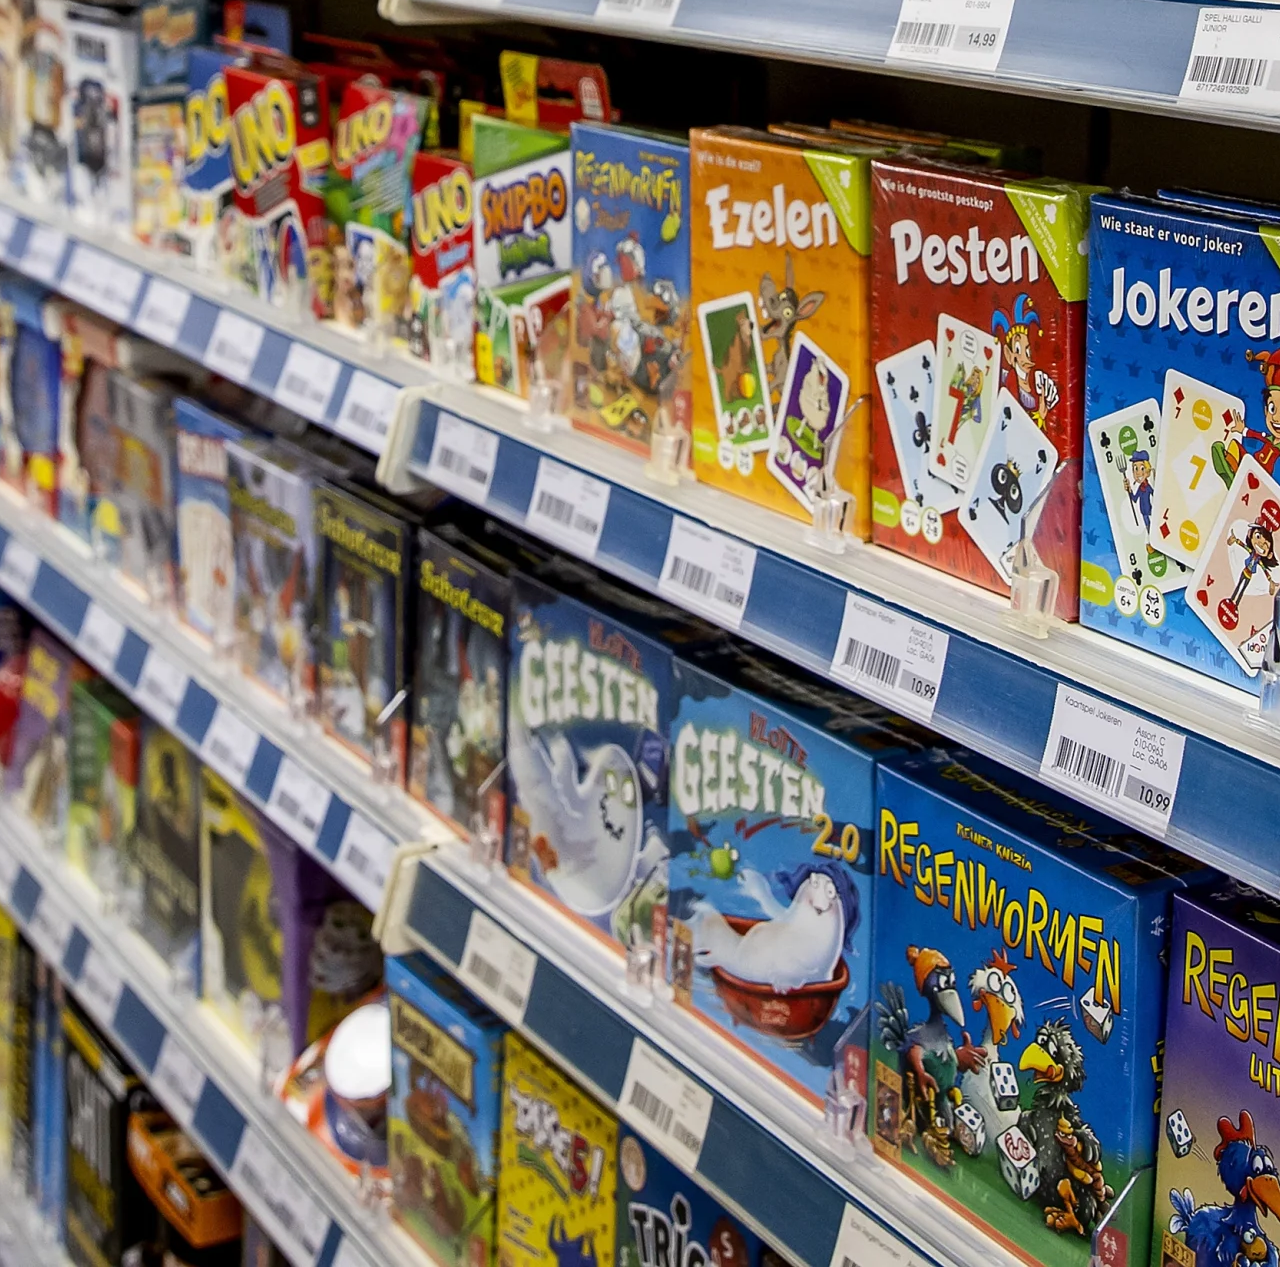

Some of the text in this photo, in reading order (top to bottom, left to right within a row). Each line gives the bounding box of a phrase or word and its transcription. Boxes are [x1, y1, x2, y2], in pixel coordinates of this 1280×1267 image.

[1202, 24, 1228, 33] JUNIOR
[1204, 13, 1263, 24] SPEL HALLI GALLI
[968, 32, 996, 48] 14,99
[230, 83, 297, 188] UNO
[336, 99, 393, 166] UNO
[413, 170, 473, 247] UNO
[897, 180, 905, 193] is
[906, 182, 917, 196] de
[918, 186, 954, 204] grootste
[955, 194, 994, 212] pestkop?
[705, 183, 839, 250] Ezelen
[1100, 214, 1244, 257] Wie staat er voor joker?
[890, 219, 1039, 285] Pesten
[1119, 594, 1132, 609] 6+
[1144, 603, 1161, 620] 2-6
[521, 639, 659, 732] GEESTEN
[910, 676, 936, 700] 10,99
[1065, 694, 1123, 728] Kaartspel Jokeren
[1135, 725, 1166, 747] Assort. C
[674, 720, 826, 820] GEESTEN
[1132, 747, 1168, 772] Loc. GA06
[1138, 784, 1172, 812] 10,99
[811, 812, 861, 864] 2.0
[955, 821, 1034, 874] REINER KNIZIA
[879, 807, 1121, 1015] REGENWORMEN
